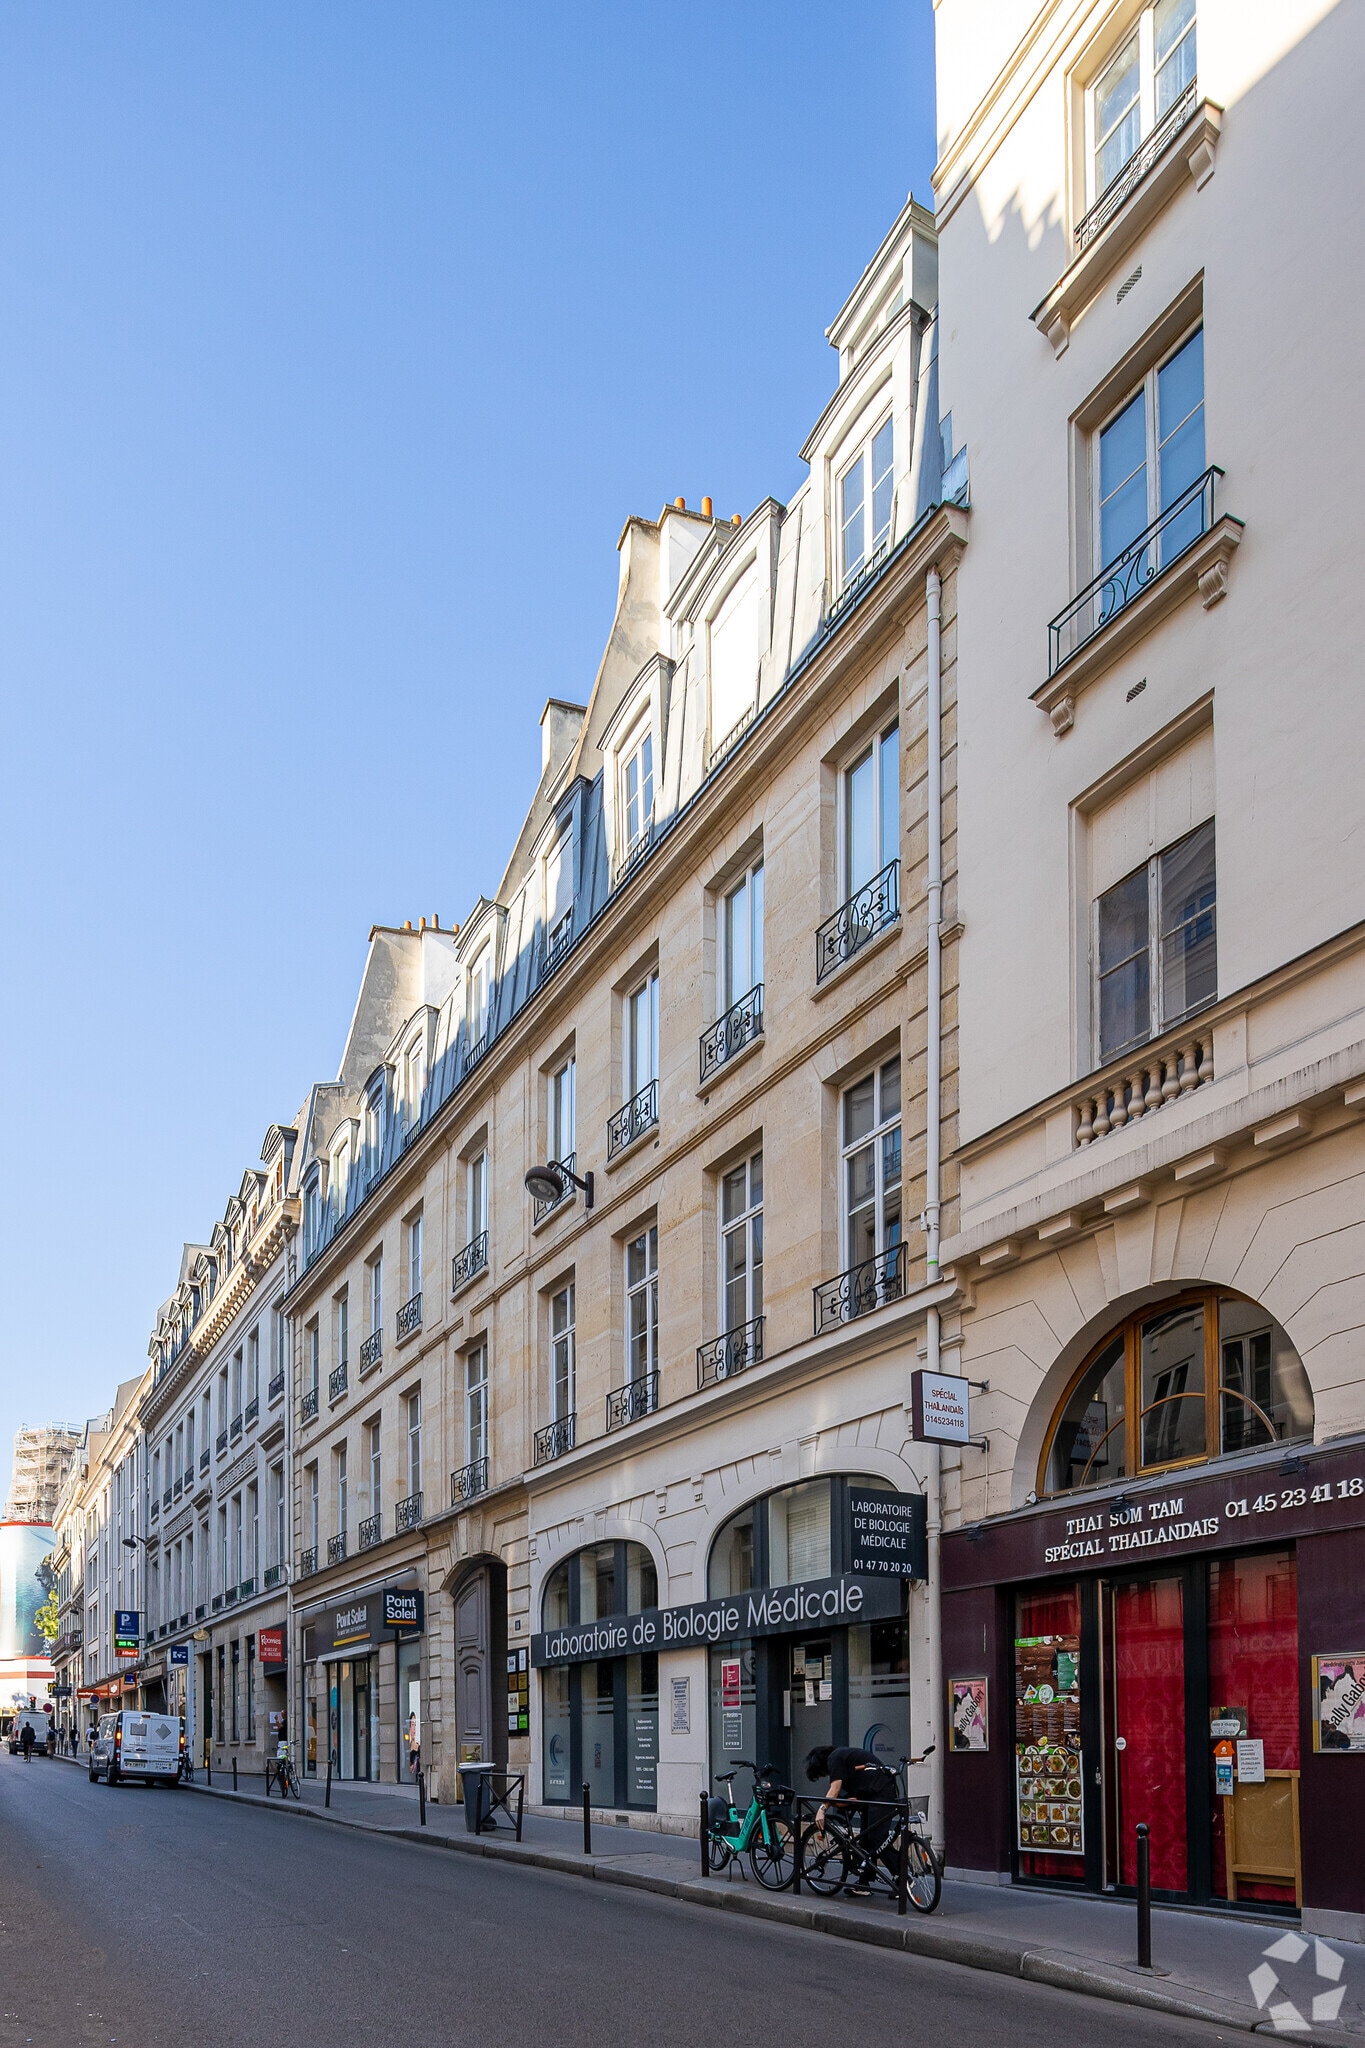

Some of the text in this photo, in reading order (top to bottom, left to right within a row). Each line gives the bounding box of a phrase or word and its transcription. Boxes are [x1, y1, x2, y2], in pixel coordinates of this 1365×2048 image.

[925, 1414, 965, 1428] 0145234118
[1225, 1478, 1364, 1518] 01 45 23 41 18
[851, 1500, 912, 1517] LABORATOIRE
[1066, 1498, 1184, 1536] THAI SOM TAM
[854, 1517, 910, 1533] DE BIOLOGIE
[861, 1533, 907, 1549] MÉDICALE
[1044, 1517, 1220, 1563] SPÉCIAL THAILANDAIS
[853, 1559, 912, 1573] 01 47 70 20 20
[386, 1595, 416, 1608] Point
[121, 1613, 130, 1626] P
[336, 1605, 367, 1629] Point Soleil
[386, 1607, 417, 1620] Soleil
[545, 1579, 864, 1659] Laboratoire de Biologie Médicale
[965, 1687, 985, 1717] Gabori
[1330, 1703, 1351, 1726] ally
[741, 1810, 753, 1836] TIER
